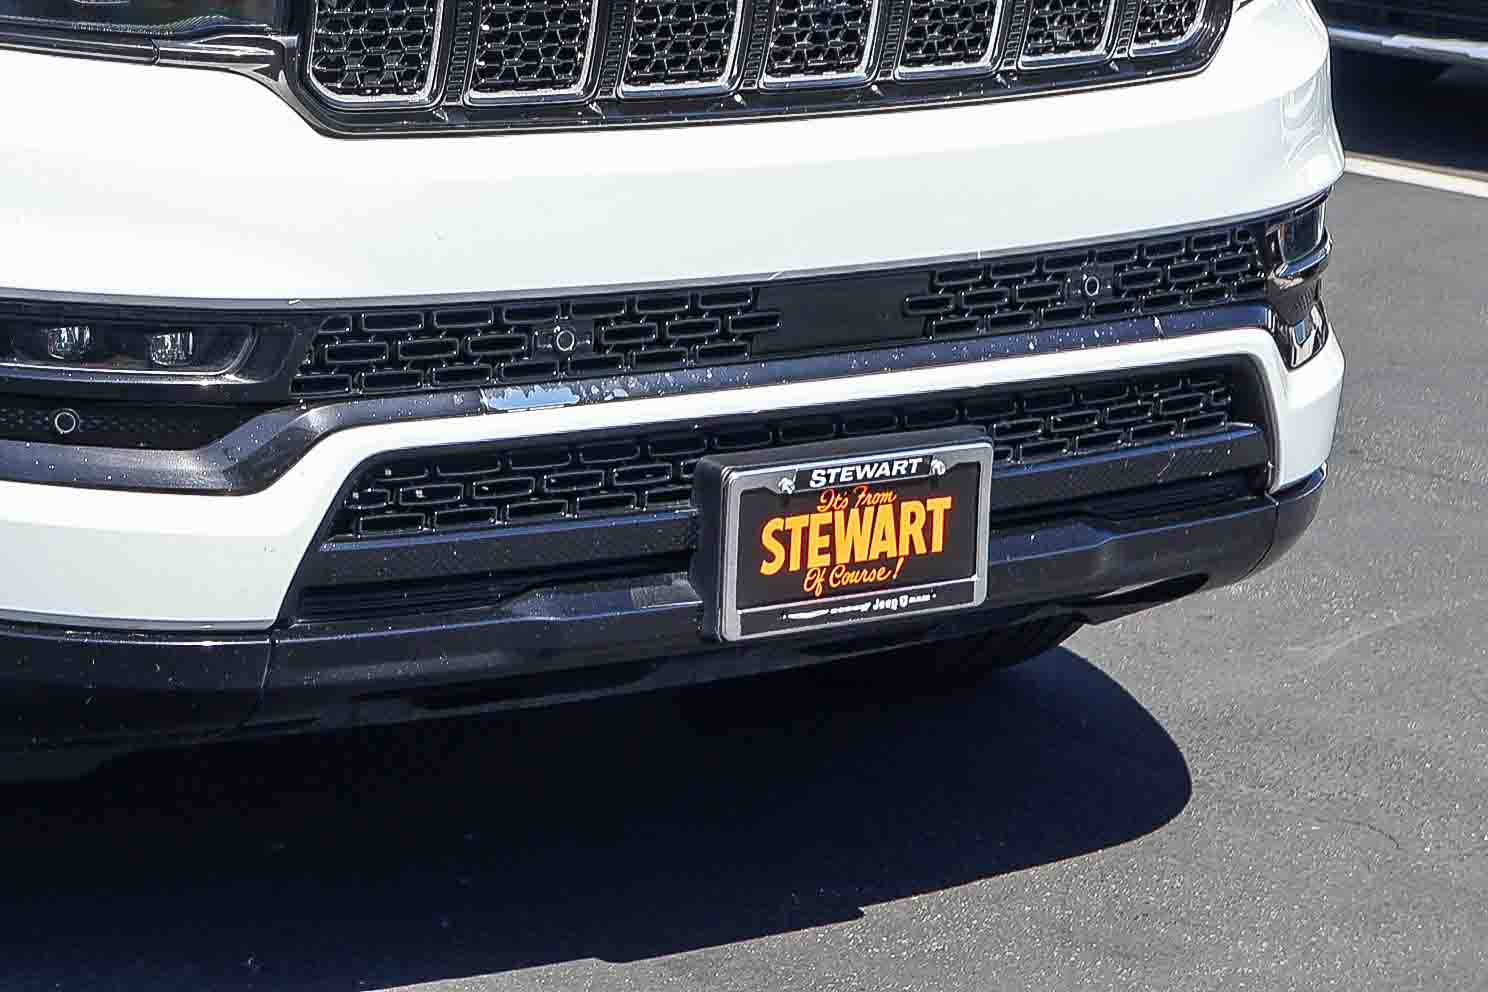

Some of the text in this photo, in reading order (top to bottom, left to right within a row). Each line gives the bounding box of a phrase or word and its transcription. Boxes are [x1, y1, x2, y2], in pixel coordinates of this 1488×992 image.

[810, 457, 923, 488] STEWART
[817, 485, 897, 512] It's From
[760, 496, 952, 576] STEWART
[803, 557, 905, 597] Of Course!
